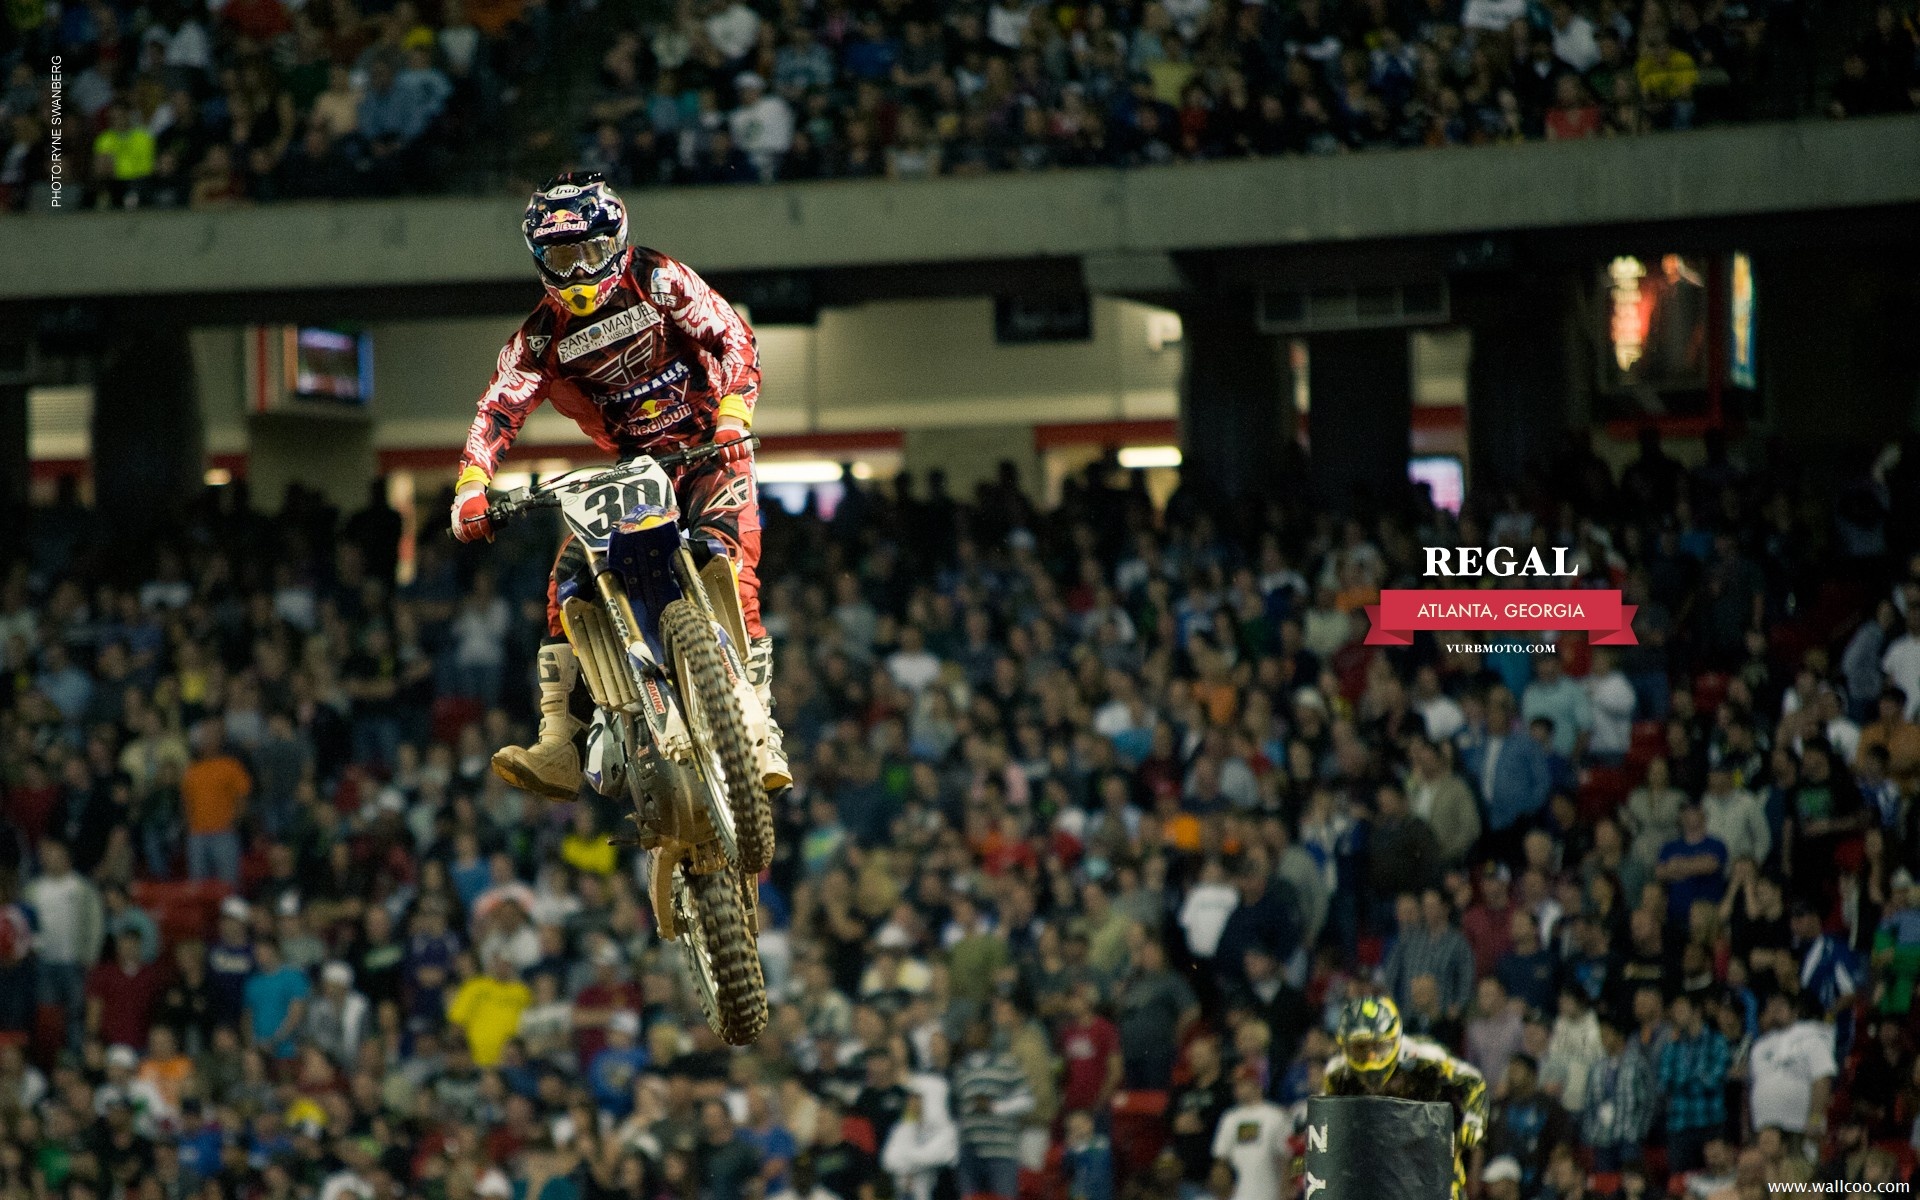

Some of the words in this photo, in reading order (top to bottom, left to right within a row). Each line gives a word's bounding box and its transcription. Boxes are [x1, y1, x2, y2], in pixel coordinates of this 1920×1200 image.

[533, 225, 559, 239] Red
[560, 220, 588, 232] Bull
[559, 332, 588, 355] SAN
[601, 303, 655, 335] MANUEL
[561, 348, 582, 362] BAND
[582, 344, 591, 353] OF
[607, 327, 634, 342] MISSION
[629, 418, 662, 436] Red
[661, 403, 692, 429] Bull
[584, 478, 662, 537] 30
